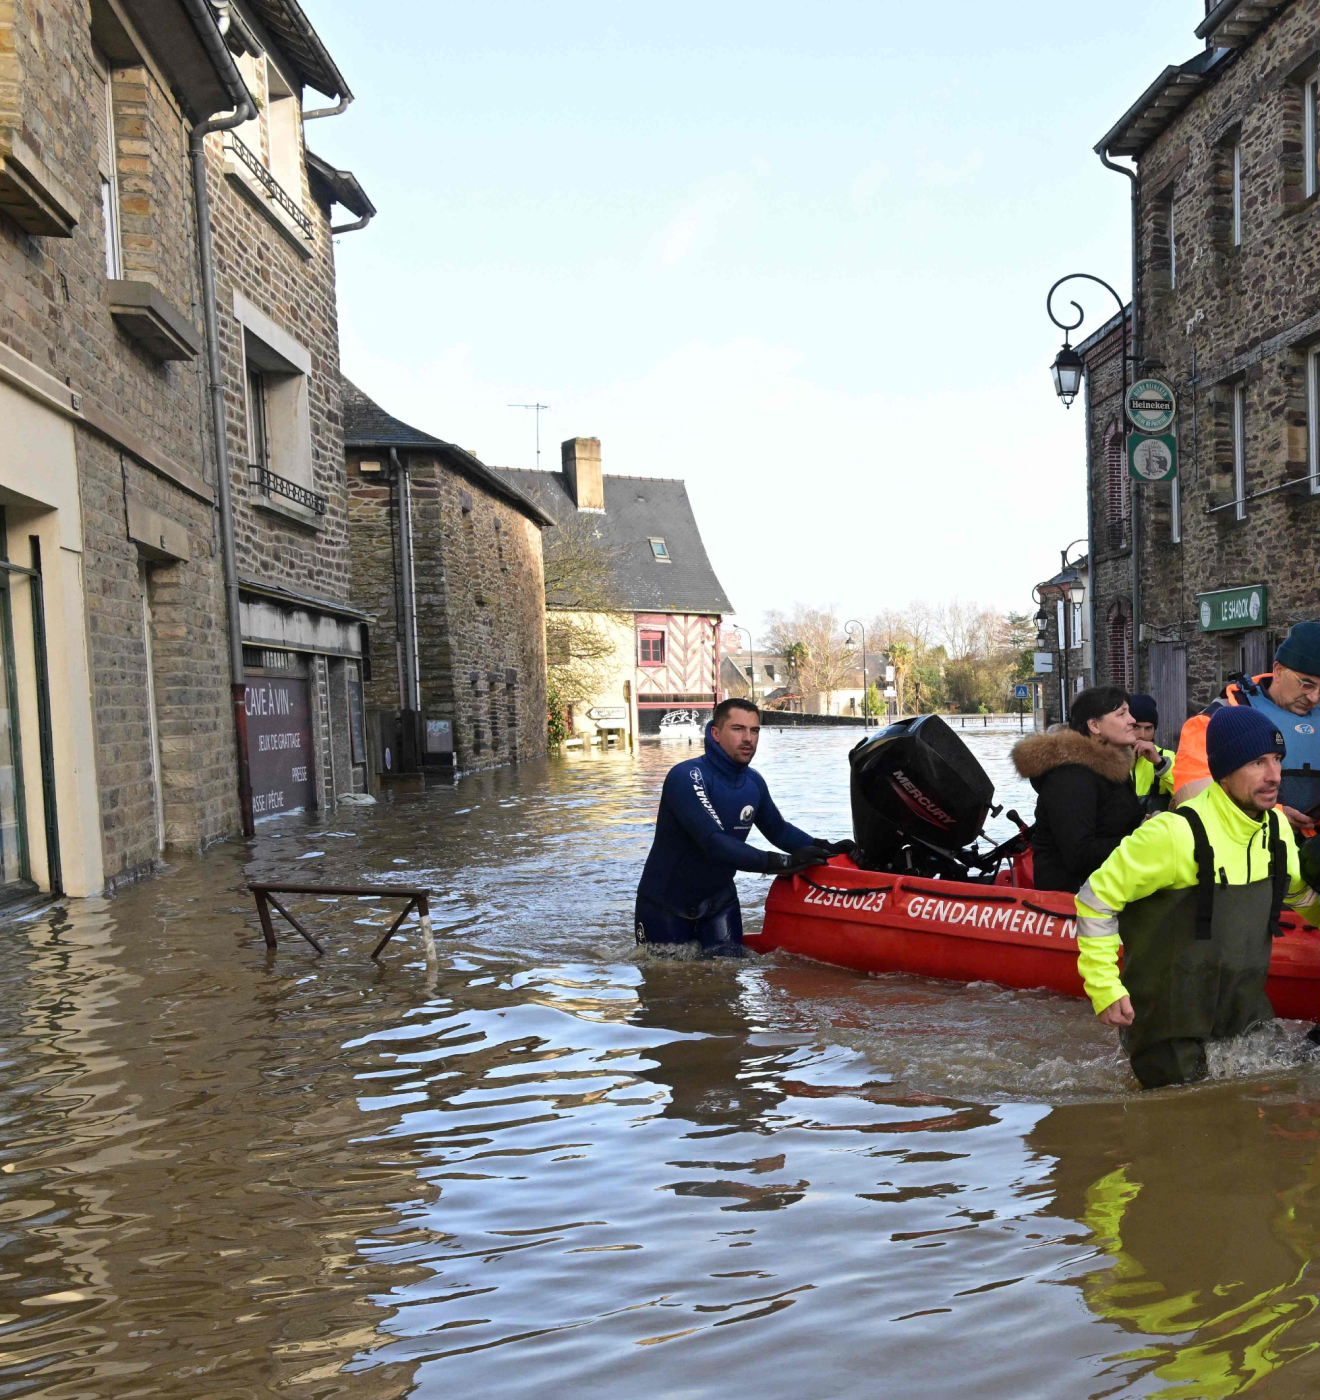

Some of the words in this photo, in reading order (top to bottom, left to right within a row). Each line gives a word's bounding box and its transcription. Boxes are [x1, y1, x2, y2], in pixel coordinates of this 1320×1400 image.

[1132, 400, 1171, 410] Heineken
[245, 687, 267, 716] CAVE
[268, 683, 275, 715] À
[275, 689, 290, 715] VIN
[258, 734, 271, 751] JEUX
[272, 734, 278, 750] DE
[279, 732, 300, 750] GRATTAGE
[292, 766, 307, 783] PRESSE
[893, 770, 956, 824] MERCURY
[907, 897, 1055, 936] GENDARMERIE
